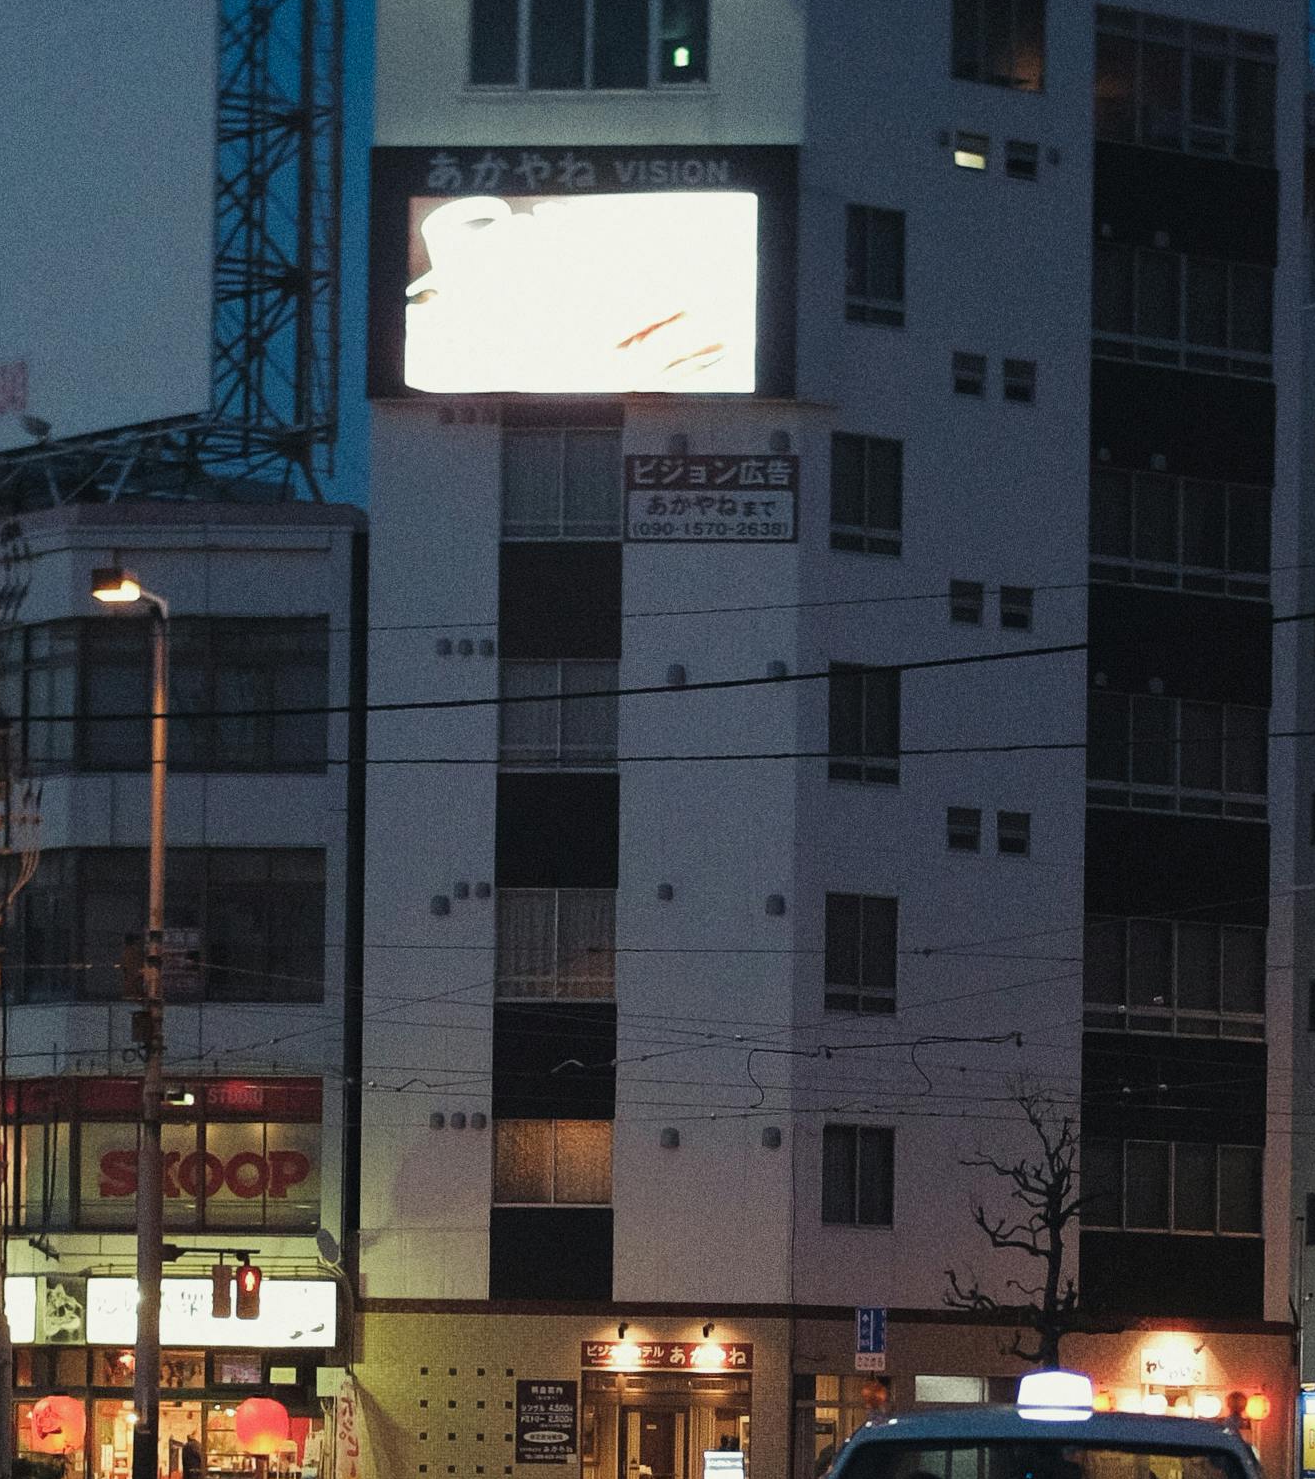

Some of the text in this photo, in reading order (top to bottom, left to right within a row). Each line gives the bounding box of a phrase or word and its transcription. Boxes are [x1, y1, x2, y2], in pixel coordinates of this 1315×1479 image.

[427, 152, 729, 189] あかやね VISION
[634, 459, 792, 485] ビジョン広告
[647, 496, 777, 517] あかやねまで
